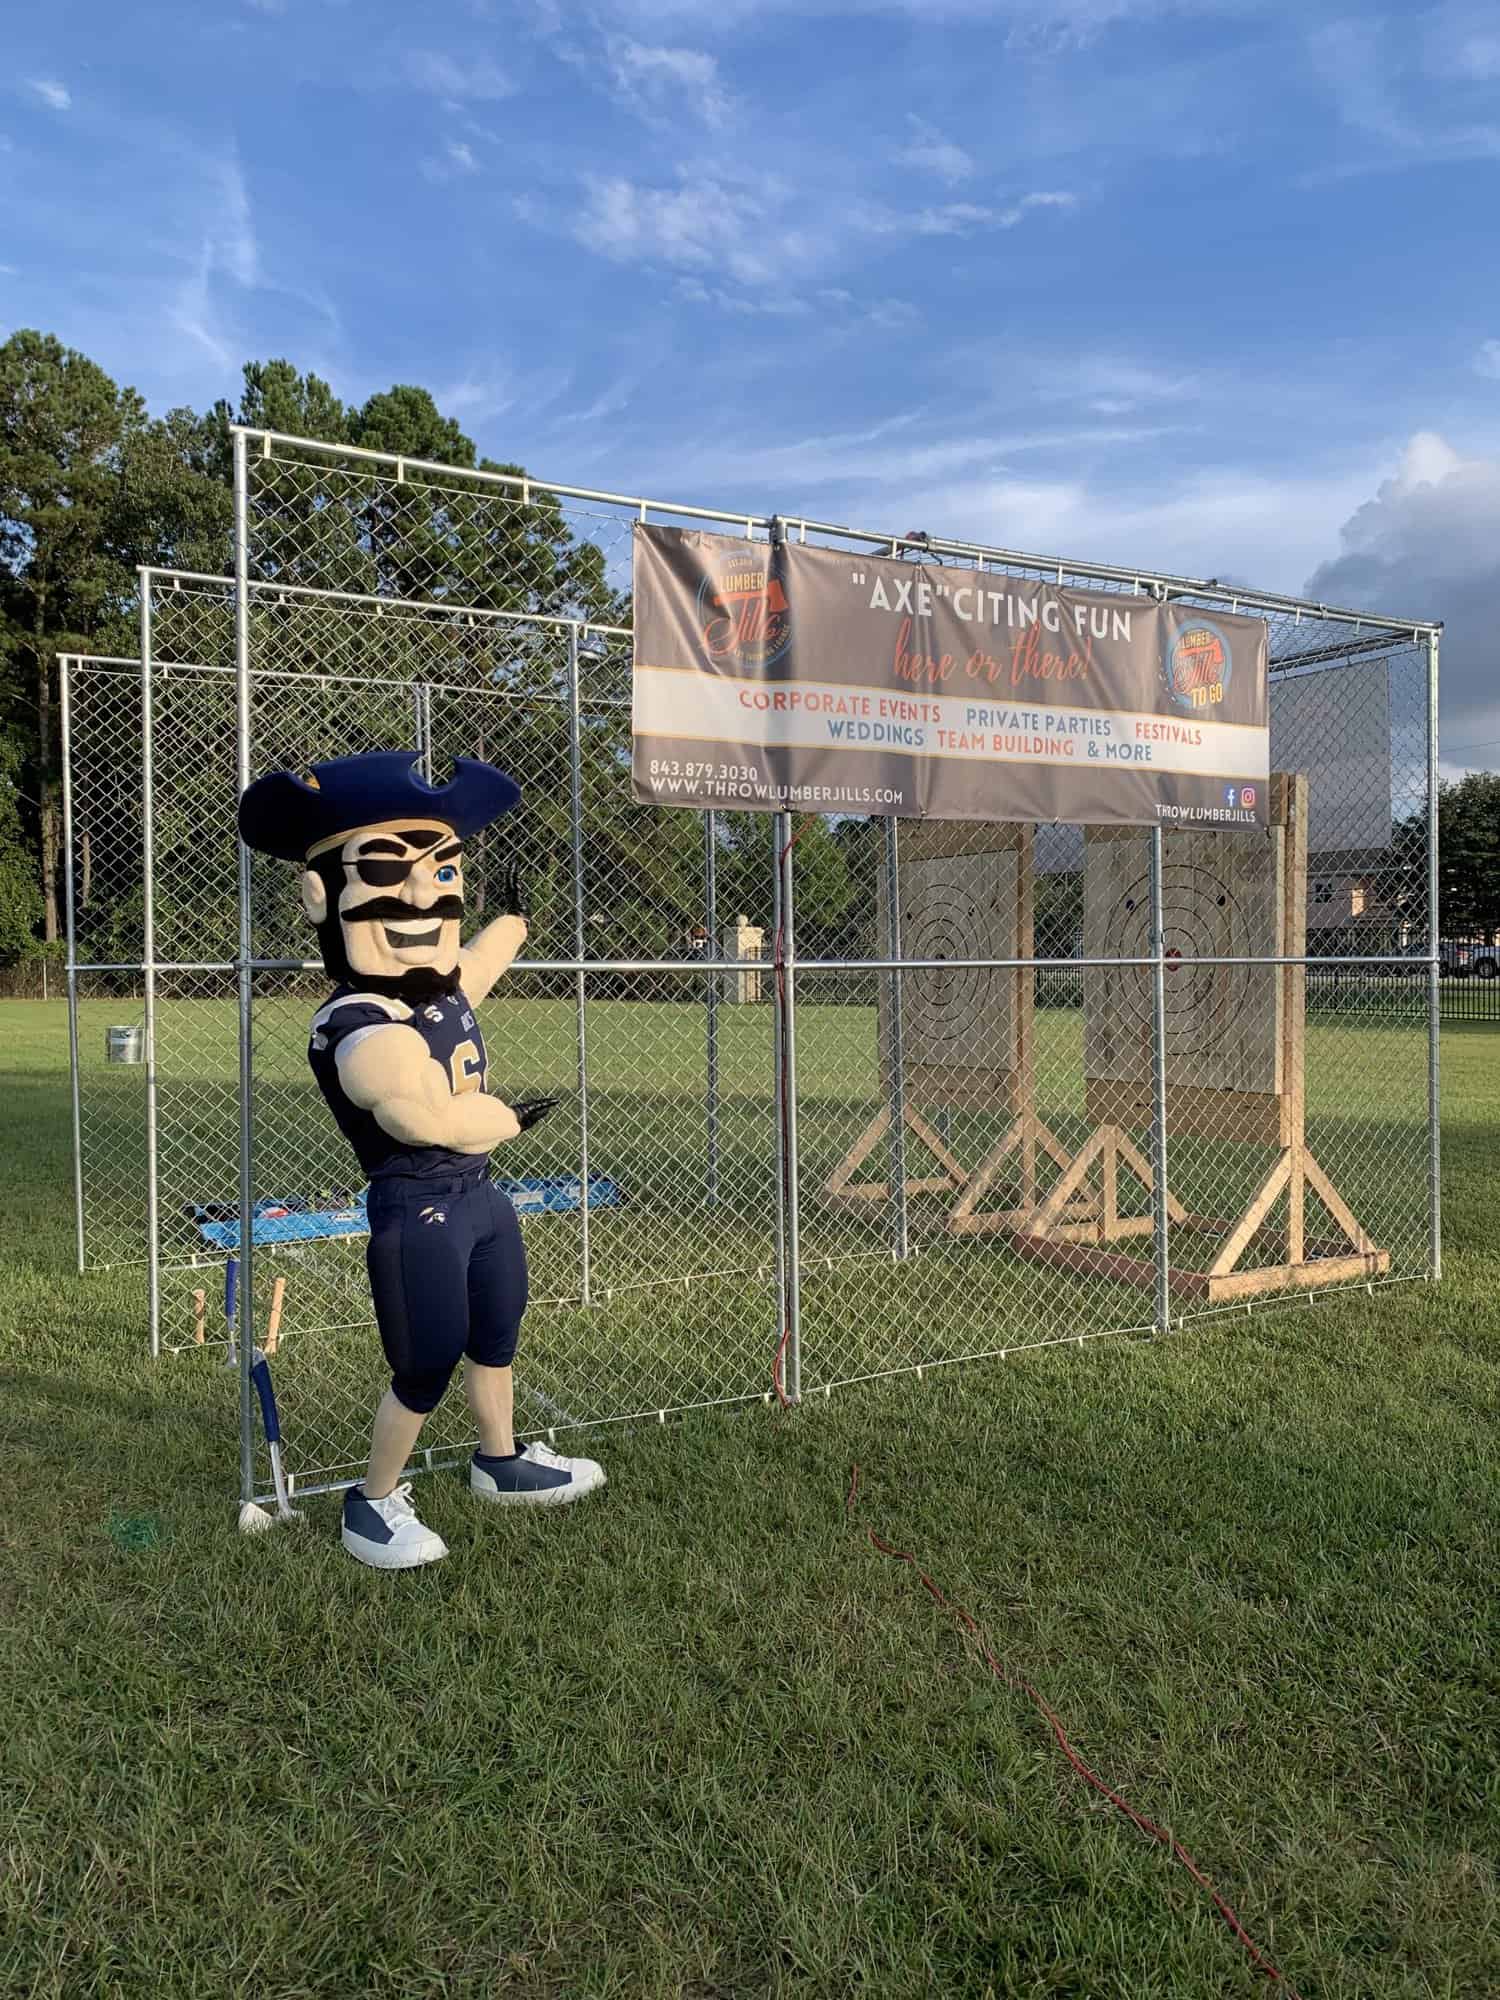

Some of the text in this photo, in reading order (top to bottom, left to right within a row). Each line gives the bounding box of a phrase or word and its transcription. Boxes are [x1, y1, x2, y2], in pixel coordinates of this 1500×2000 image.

[720, 572, 764, 592] LUMBER
[1074, 605, 1132, 642] FUN
[893, 617, 1093, 687] here or there!
[1191, 682, 1223, 708] TO GO
[739, 689, 1202, 746] CORPORATE EVENTS PRIVATE PARTIES FESTIVALS
[827, 719, 1152, 761] WEDDINGS TEAM BUILDING & MORE
[650, 759, 758, 782] 843.879.3030
[650, 777, 903, 805] WWW.THROWLUMBERJILLS.COM
[1154, 803, 1257, 823] THROWLUMBERJILLS
